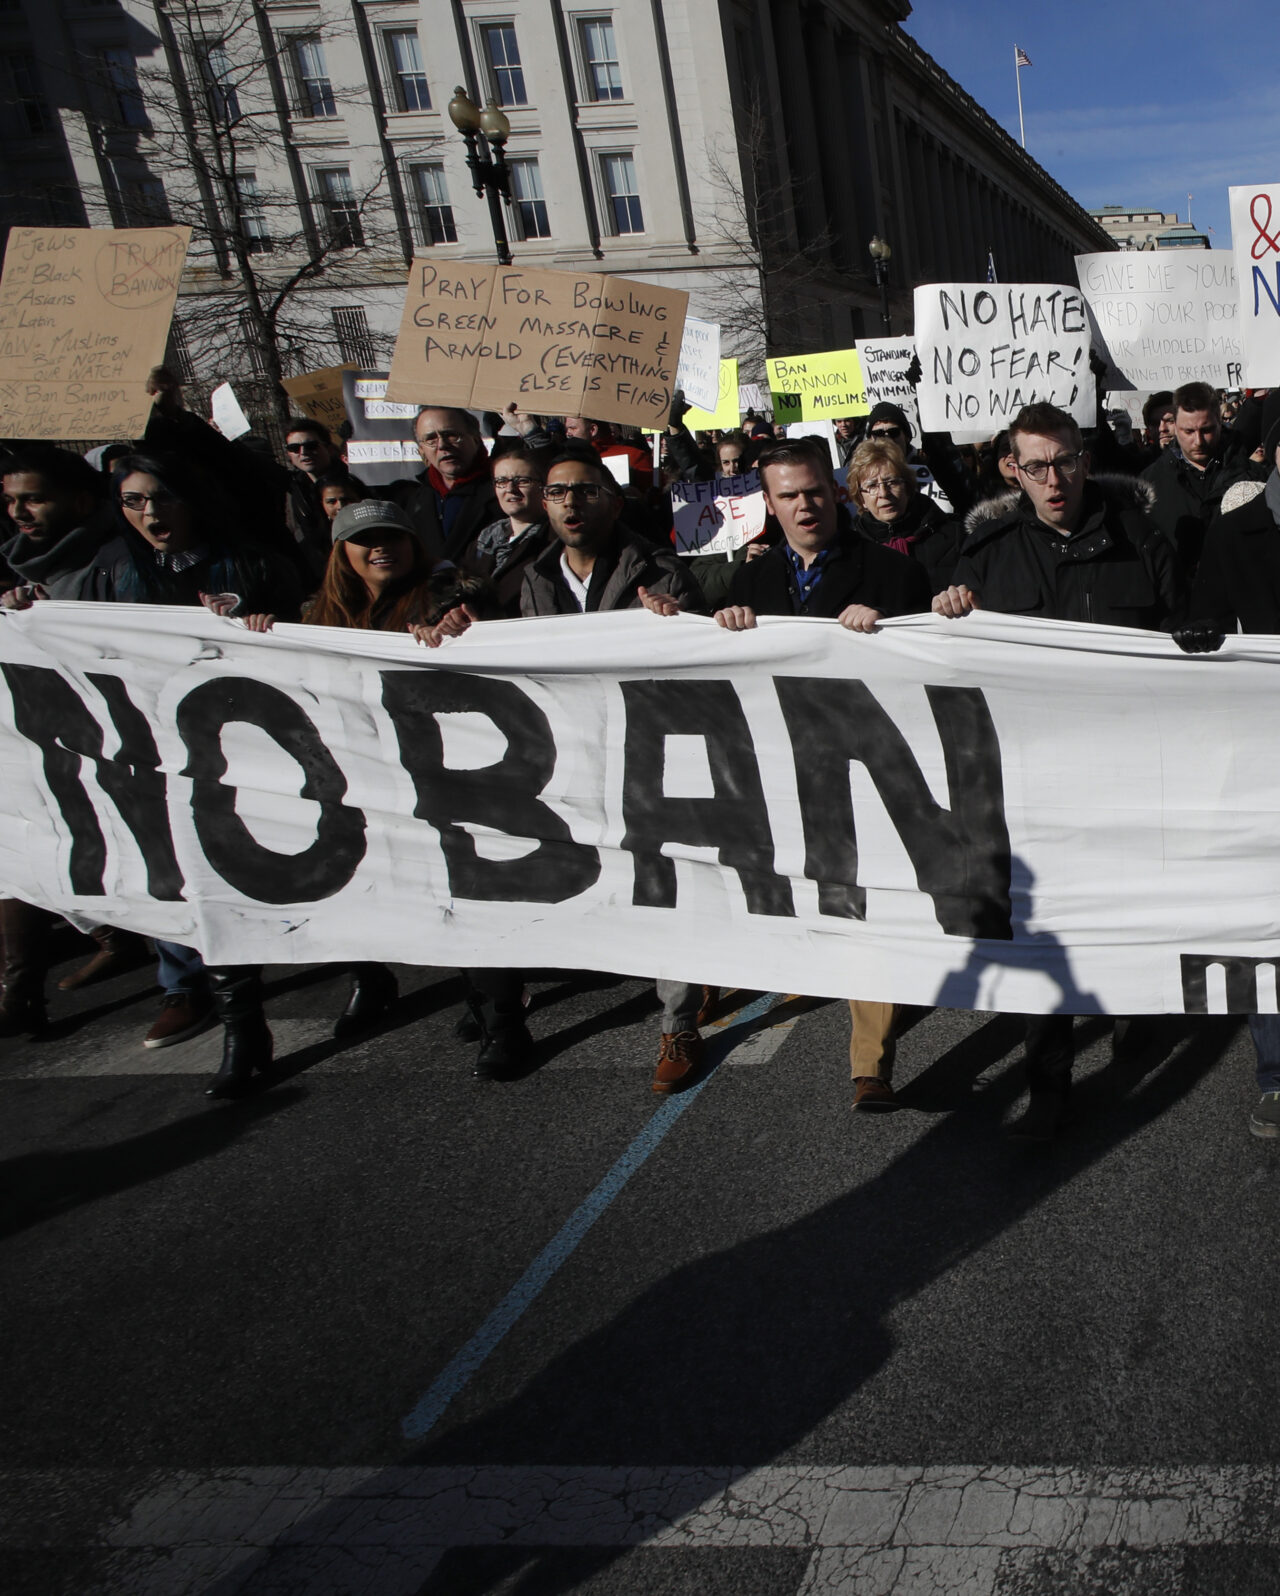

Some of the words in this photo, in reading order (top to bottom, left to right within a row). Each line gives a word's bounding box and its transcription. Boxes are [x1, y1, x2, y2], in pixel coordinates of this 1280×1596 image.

[421, 266, 487, 301] PRAY
[502, 274, 552, 305] FOR
[1147, 264, 1176, 289] ME
[939, 289, 998, 331] NO
[1145, 301, 1196, 324] YOUR
[413, 304, 497, 331] GREEN
[519, 317, 644, 345] MASSACRE
[425, 336, 522, 362] ARNOLD
[540, 344, 673, 382] (EVERYTHING
[864, 345, 911, 363] STANDING
[1142, 336, 1205, 357] HUDDLED
[774, 360, 807, 378] BAN
[934, 345, 981, 385] NO
[990, 344, 1083, 379] FEAR!
[1161, 366, 1174, 380] TO
[1177, 363, 1222, 381] BREATH
[781, 372, 847, 393] BANNON
[867, 386, 882, 401] MY
[583, 376, 601, 392] IS
[616, 383, 671, 418] FINE)
[777, 393, 802, 411] NOT
[813, 392, 868, 409] MUSLIMS
[945, 392, 980, 421] NO
[349, 447, 377, 457] SAVE
[384, 446, 400, 456] US
[698, 496, 746, 527] ARE
[676, 527, 741, 555] Welcome
[0, 662, 368, 906] NO
[379, 670, 1015, 942] BAN
